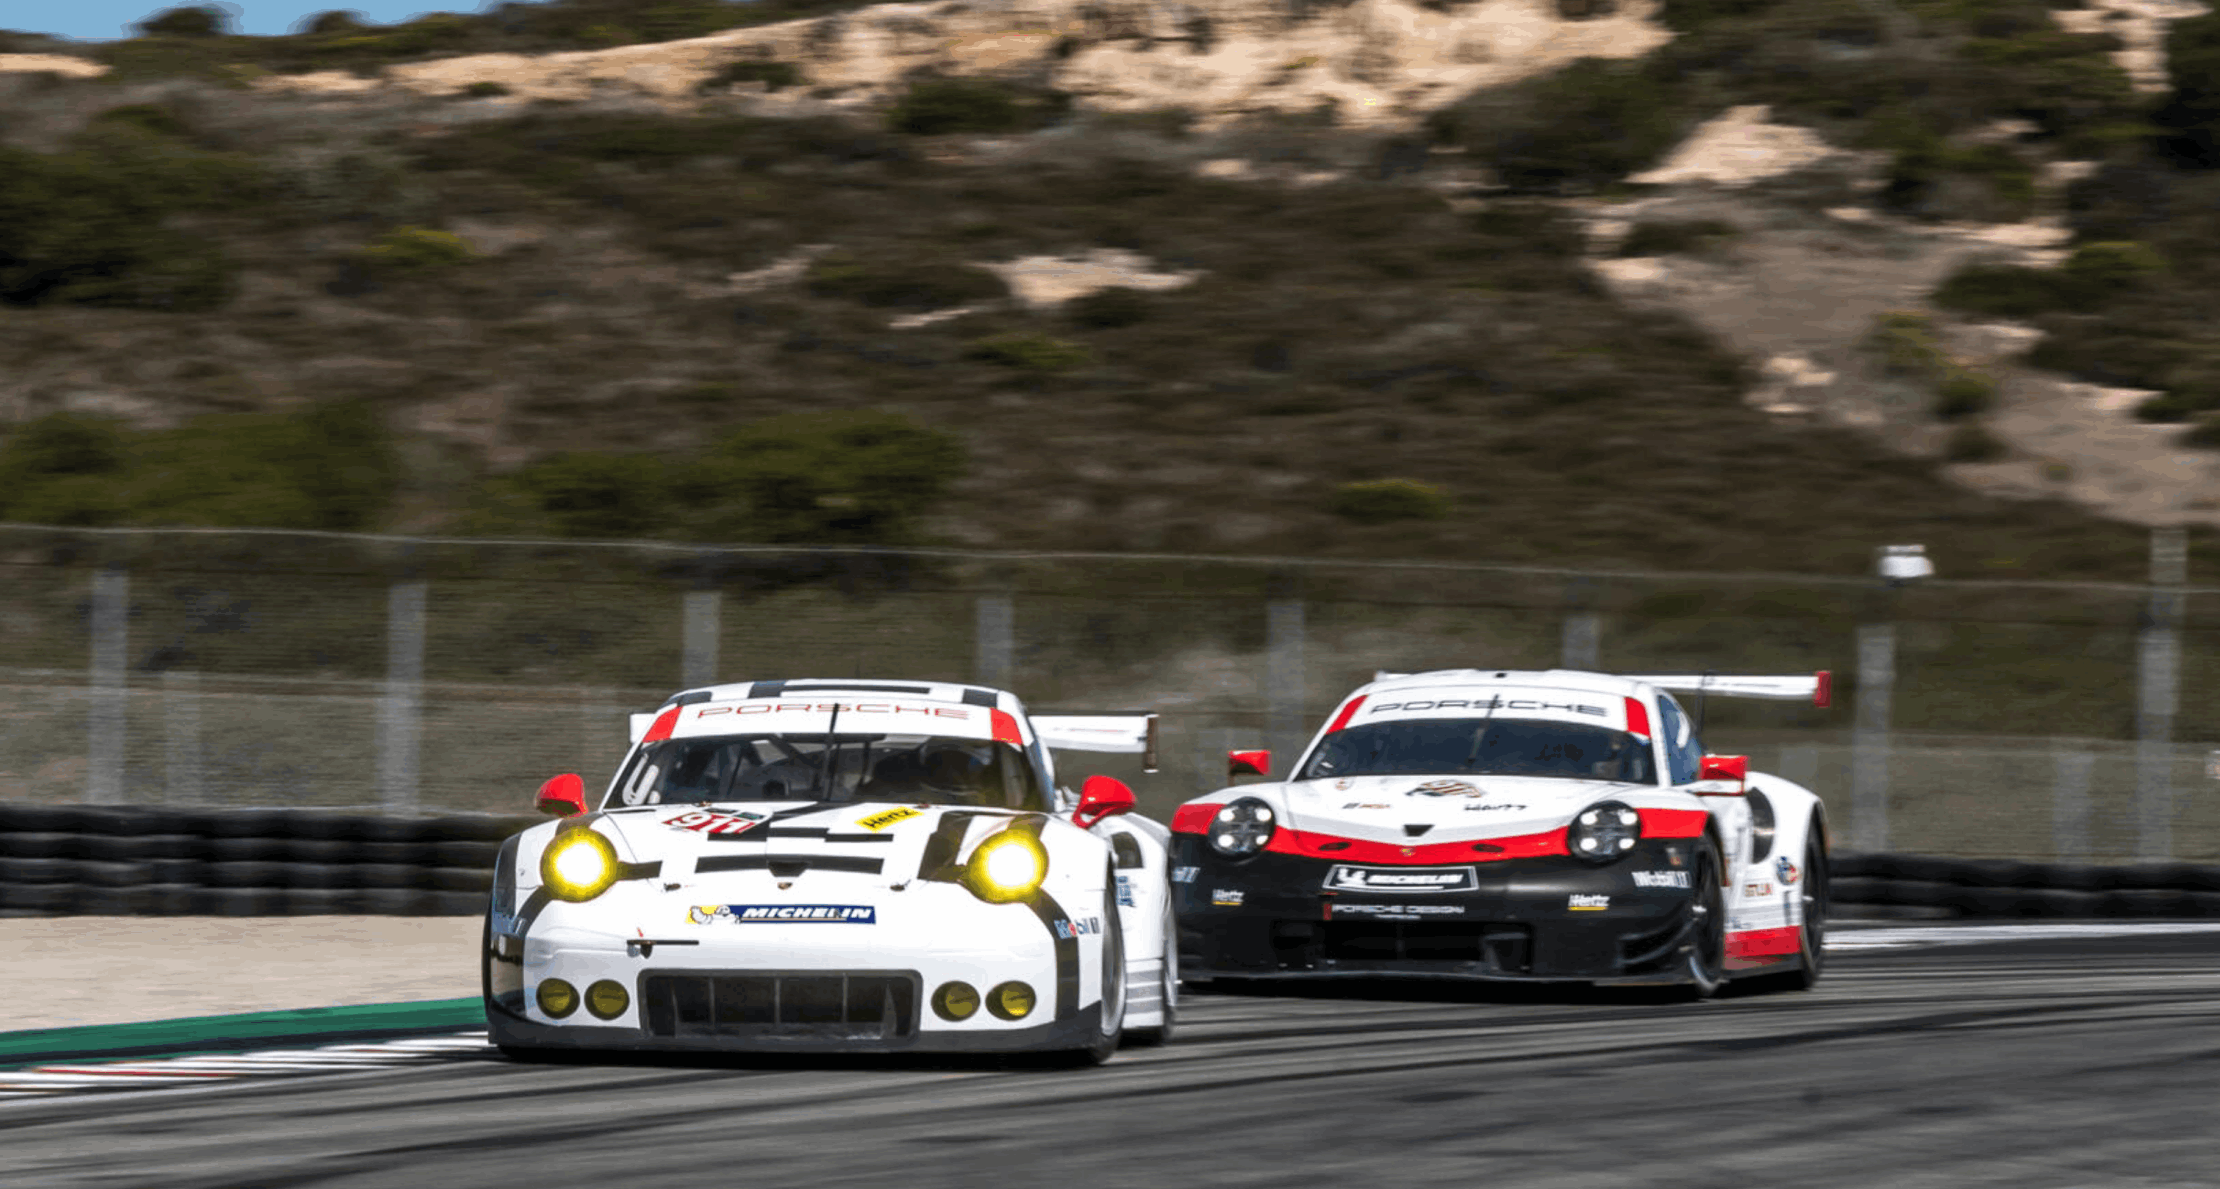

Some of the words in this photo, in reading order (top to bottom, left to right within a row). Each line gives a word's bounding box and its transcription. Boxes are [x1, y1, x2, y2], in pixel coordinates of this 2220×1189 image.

[697, 703, 970, 720] PORSCHE
[1369, 700, 1608, 717] PORSCHE
[862, 809, 919, 829] Hertz
[1366, 873, 1464, 885] MICHELIN
[1631, 870, 1677, 888] Mobil
[1568, 894, 1610, 907] Hertz
[741, 907, 873, 919] MICHELIN
[1332, 903, 1404, 914] PORSCHE
